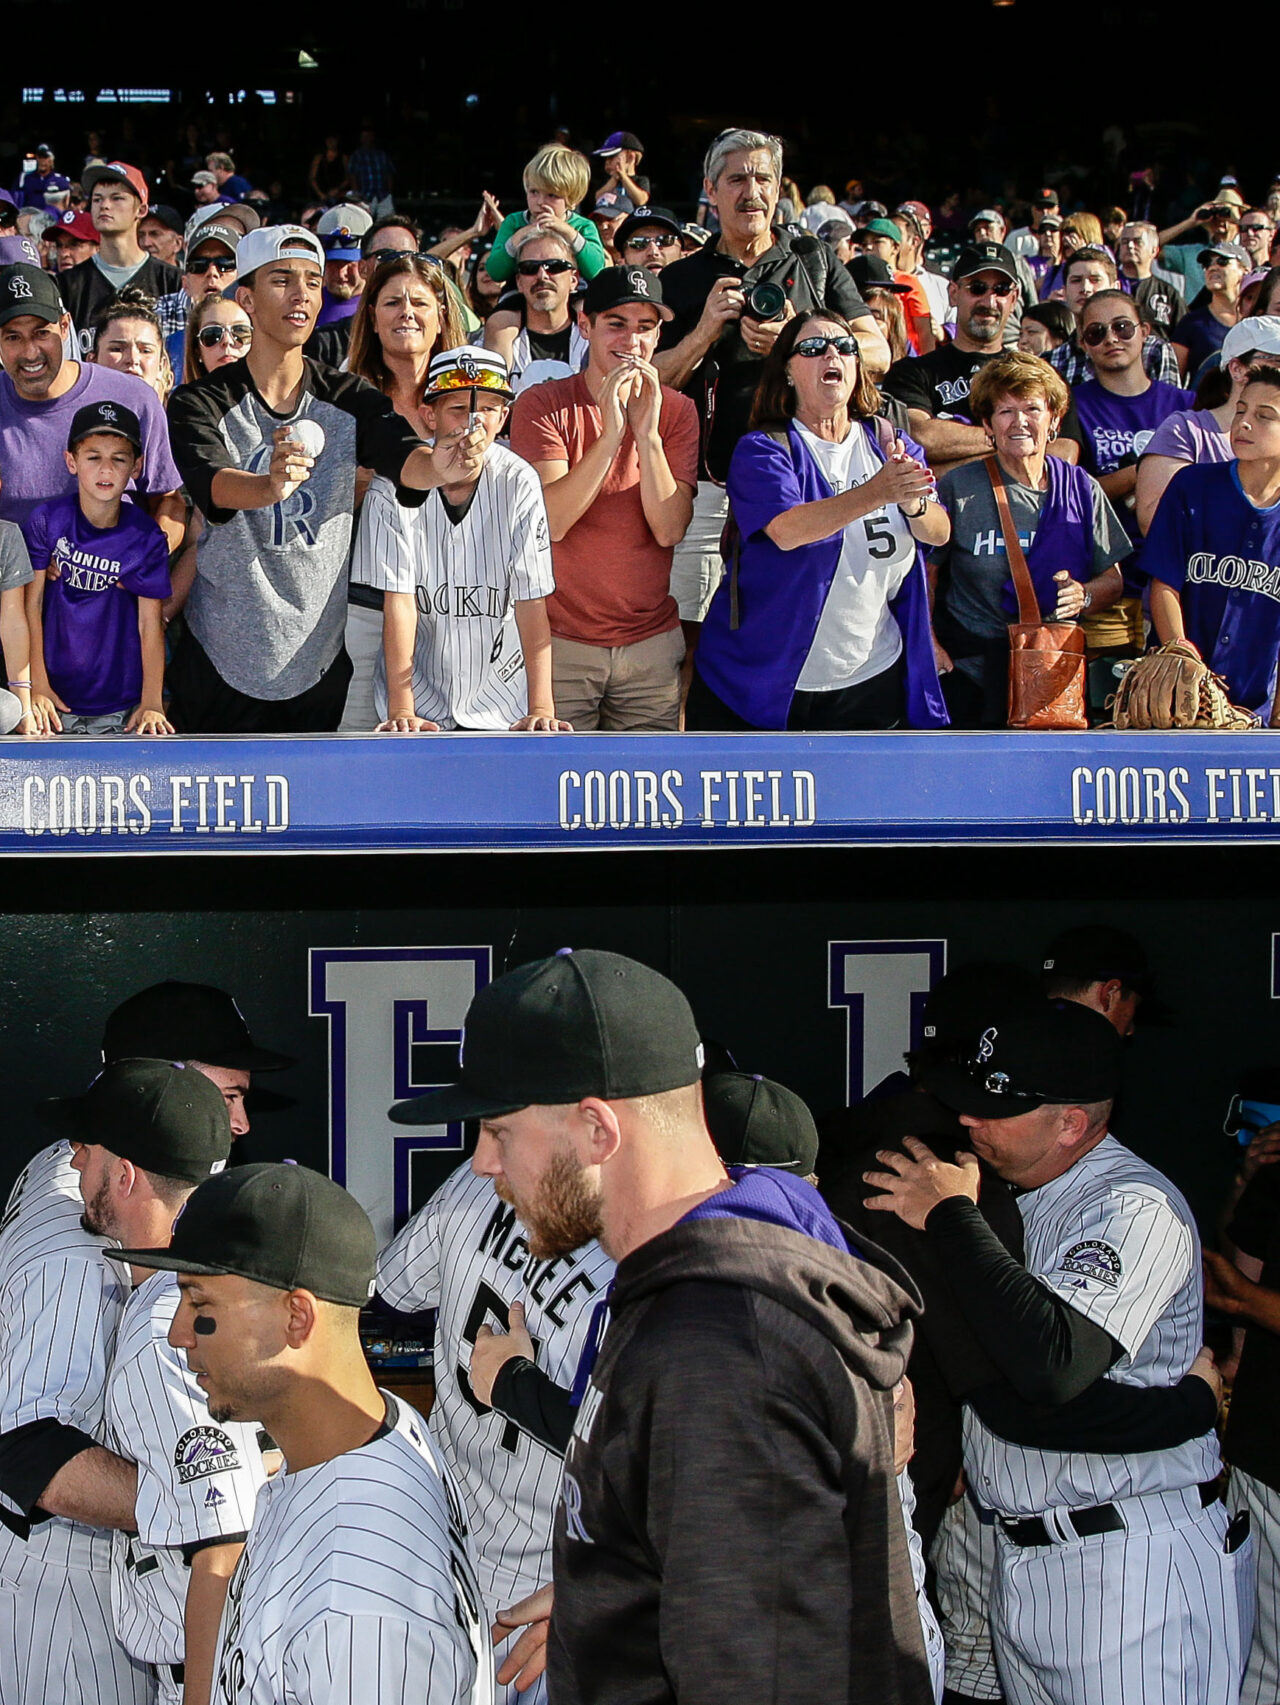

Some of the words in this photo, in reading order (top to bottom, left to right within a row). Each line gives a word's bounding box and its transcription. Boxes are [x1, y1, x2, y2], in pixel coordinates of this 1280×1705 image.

[935, 376, 971, 406] RO
[863, 516, 897, 559] 5
[22, 774, 152, 837] COORS
[169, 774, 291, 834] FIELD
[558, 769, 684, 831] COORS
[699, 770, 816, 828] FIELD
[1071, 766, 1191, 825] COORS
[175, 1427, 232, 1461] COLORADO
[176, 1450, 240, 1482] ROCKIES
